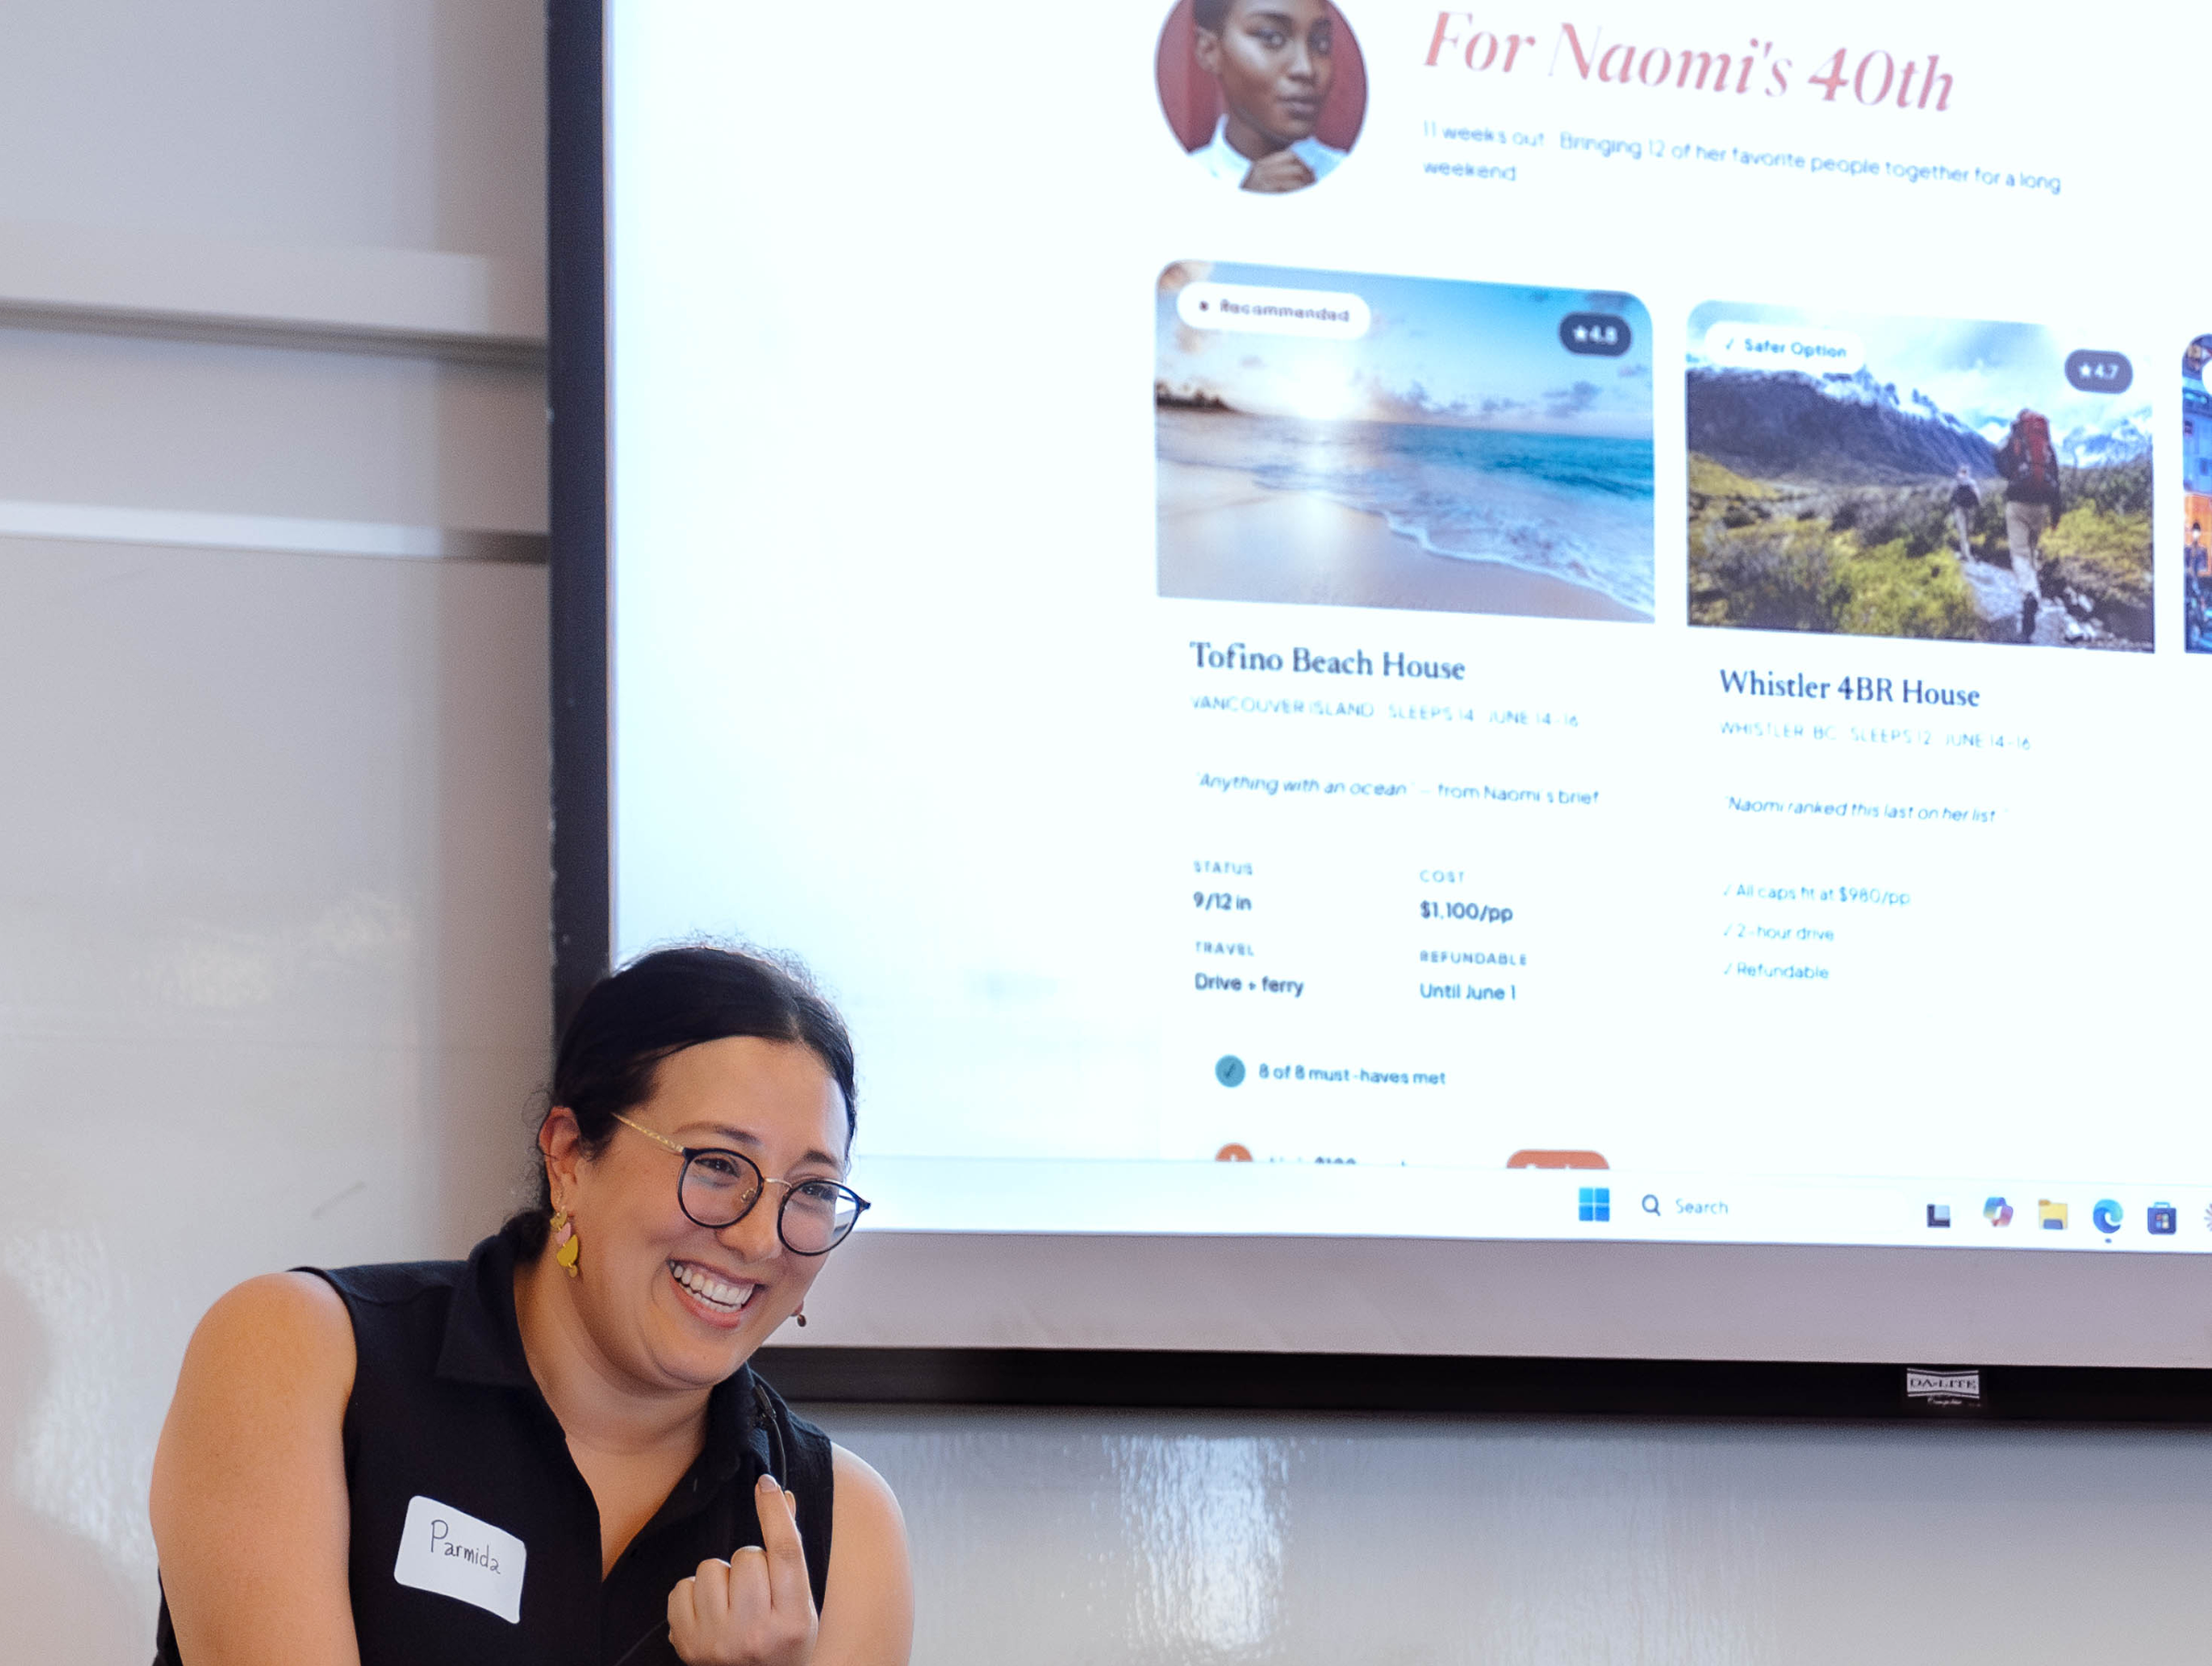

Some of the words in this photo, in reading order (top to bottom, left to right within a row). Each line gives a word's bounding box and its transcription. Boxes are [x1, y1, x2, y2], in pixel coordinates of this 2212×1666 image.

[1423, 11, 1536, 72] For
[1548, 23, 1792, 96] Naomi's
[1808, 48, 1953, 111] 40th
[1443, 128, 1507, 144] weeks
[1512, 132, 1545, 147] out
[1560, 132, 1642, 160] Bringing
[1648, 138, 1665, 158] 12
[1671, 143, 1691, 159] of
[1696, 145, 1726, 161] her
[1732, 147, 1805, 168] favorite
[1810, 157, 1880, 177] people
[1886, 162, 1969, 183] together
[1975, 167, 2001, 185] for
[2005, 174, 2015, 187] a
[2020, 172, 2061, 195] long
[1423, 162, 1516, 181] weekend
[1745, 339, 1785, 353] Safer
[1790, 342, 1847, 359] Option
[1190, 641, 1284, 671] Tofino
[1293, 647, 1373, 675] Beach
[1383, 651, 1465, 680] House
[1720, 669, 1831, 699] Whistler
[1838, 675, 1893, 702] 4BR
[1903, 680, 1980, 707] House
[1192, 696, 1304, 714] VANCOUVER
[1310, 701, 1374, 718] ISLAND
[1389, 704, 1452, 721] SLEEPS
[1490, 710, 1527, 725] JUNE
[1851, 727, 1912, 744] SLEEPS
[1946, 734, 1982, 748] JUNE
[1283, 779, 1320, 792] with
[1324, 782, 1345, 794] an
[1438, 783, 1480, 799] from
[1558, 790, 1599, 805] brief
[1788, 802, 1848, 816] ranked
[1852, 803, 1879, 817] this
[1884, 805, 1913, 818] last
[1918, 808, 1939, 820] on
[1942, 807, 1969, 821] her
[1194, 860, 1253, 876] STATUS
[1420, 870, 1464, 884] COST
[1193, 891, 1232, 910] 9/12
[1236, 895, 1252, 910] in
[1737, 884, 1754, 897] All
[1758, 888, 1796, 901] caps
[1820, 889, 1834, 901] at
[1796, 927, 1834, 941] drive
[1196, 941, 1254, 957] TRAVEL
[1420, 950, 1527, 966] REFUNDABLE
[1737, 962, 1829, 979] Refundable
[1195, 973, 1242, 991] Drive
[1262, 976, 1304, 998] ferry
[1420, 983, 1461, 999] Until
[1466, 985, 1506, 1000] June
[1511, 985, 1515, 1000] 1
[1259, 1063, 1269, 1079] 8
[1273, 1065, 1291, 1080] of
[1295, 1064, 1305, 1080] 8
[1413, 1072, 1445, 1085] met
[1676, 1198, 1728, 1214] Search
[431, 1519, 501, 1574] Parmida
